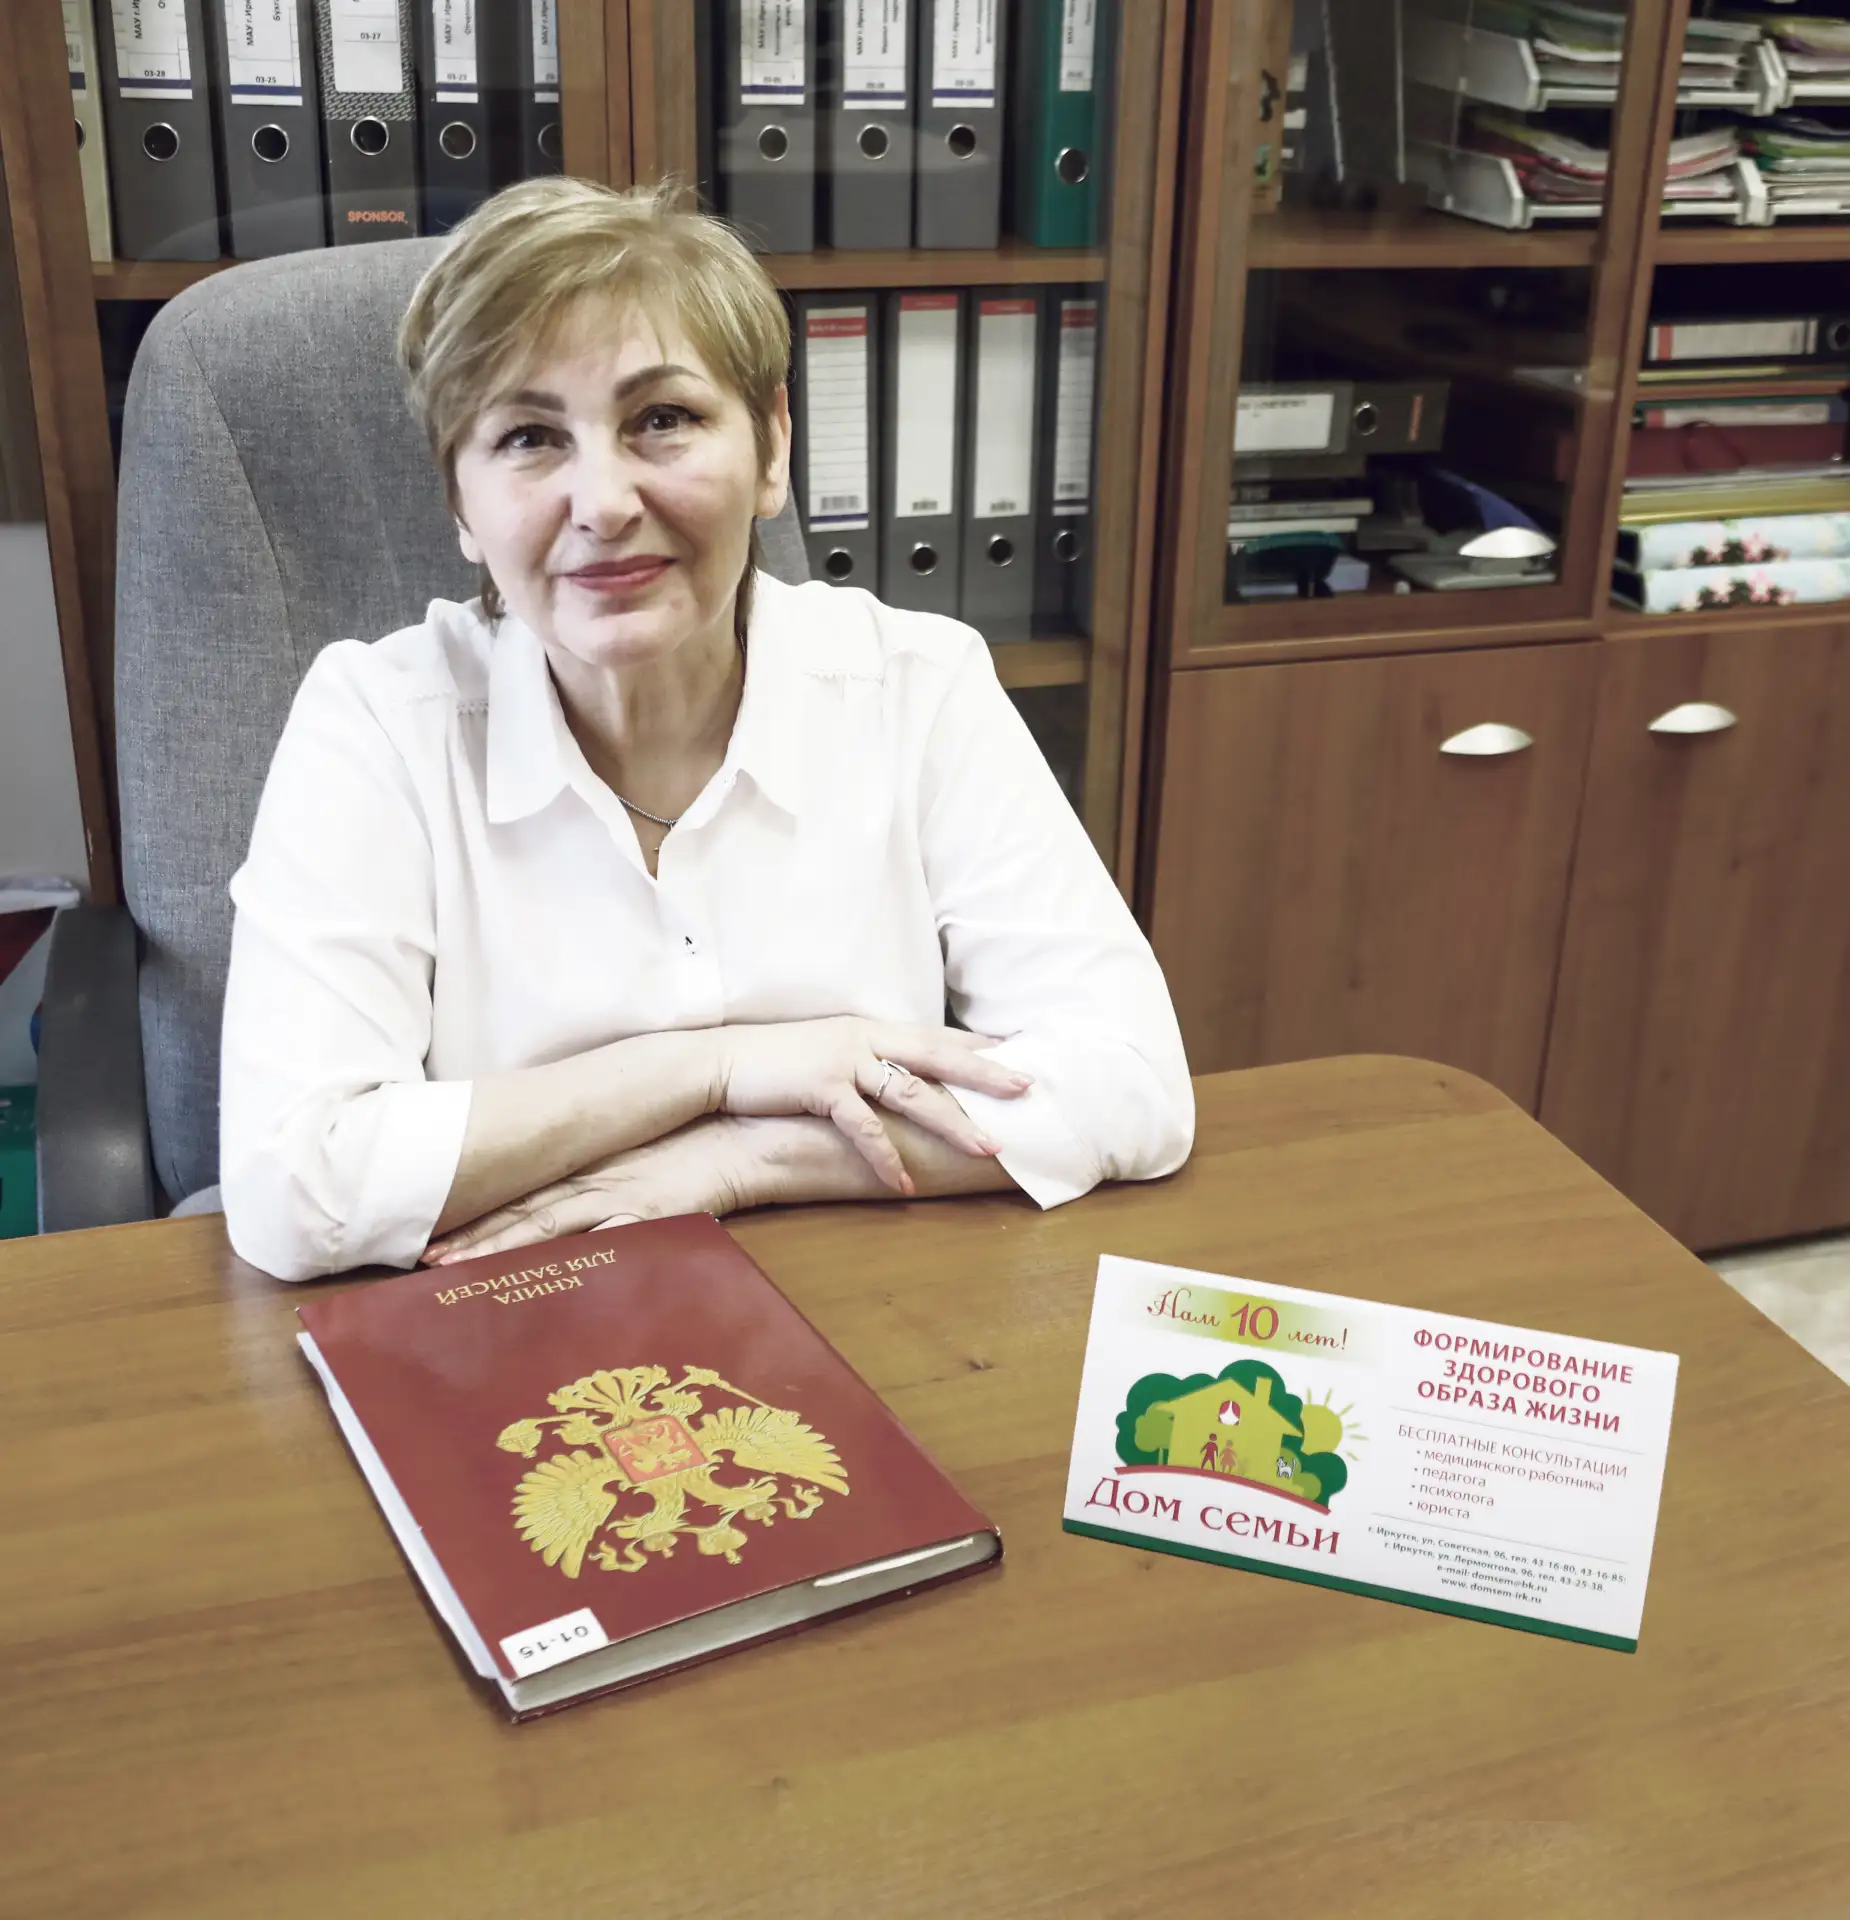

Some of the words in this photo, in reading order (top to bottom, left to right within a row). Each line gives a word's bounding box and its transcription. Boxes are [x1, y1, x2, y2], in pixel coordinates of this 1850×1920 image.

[134, 17, 143, 39] МАУ
[246, 25, 254, 46] МАУ
[360, 32, 381, 41] 03-27
[144, 69, 166, 78] 03-28
[255, 75, 277, 84] 03-25
[565, 1248, 616, 1272] ДЛЯ
[434, 1263, 562, 1306] ЗАПИСЕЙ
[492, 1275, 584, 1305] КНИГА
[1147, 1287, 1221, 1327] Нам
[1231, 1301, 1279, 1341] 10
[1288, 1328, 1348, 1350] лет!
[1413, 1328, 1634, 1385] ФОРМИРОВАНИЕ
[1443, 1359, 1600, 1404] ЗДОРОВОГО
[1417, 1380, 1517, 1415] ОБРАЗА
[1524, 1399, 1621, 1433] ЖИЗНИ
[1398, 1424, 1498, 1455] БЕСПЛАТНЫЕ
[1502, 1443, 1628, 1479] КОНСУЛЬТАЦИИ
[1422, 1466, 1487, 1488] педагога
[1424, 1449, 1526, 1477] медицинского
[1529, 1468, 1605, 1492] работника
[1416, 1501, 1470, 1520] юриста
[1419, 1484, 1495, 1507] психолога
[1084, 1477, 1183, 1522] Дом
[1200, 1505, 1340, 1555] семьи
[1376, 1526, 1419, 1543] Иркутск,
[1422, 1537, 1436, 1546] ул.
[1438, 1539, 1492, 1558] Советская,
[1392, 1542, 1435, 1558] Иркутск,
[1438, 1553, 1452, 1561] ул.
[1437, 1564, 1470, 1577] e-mail:
[1471, 1571, 1548, 1594] domsem@bk.ru
[1441, 1578, 1469, 1589] www.
[518, 1625, 589, 1659] 01-15
